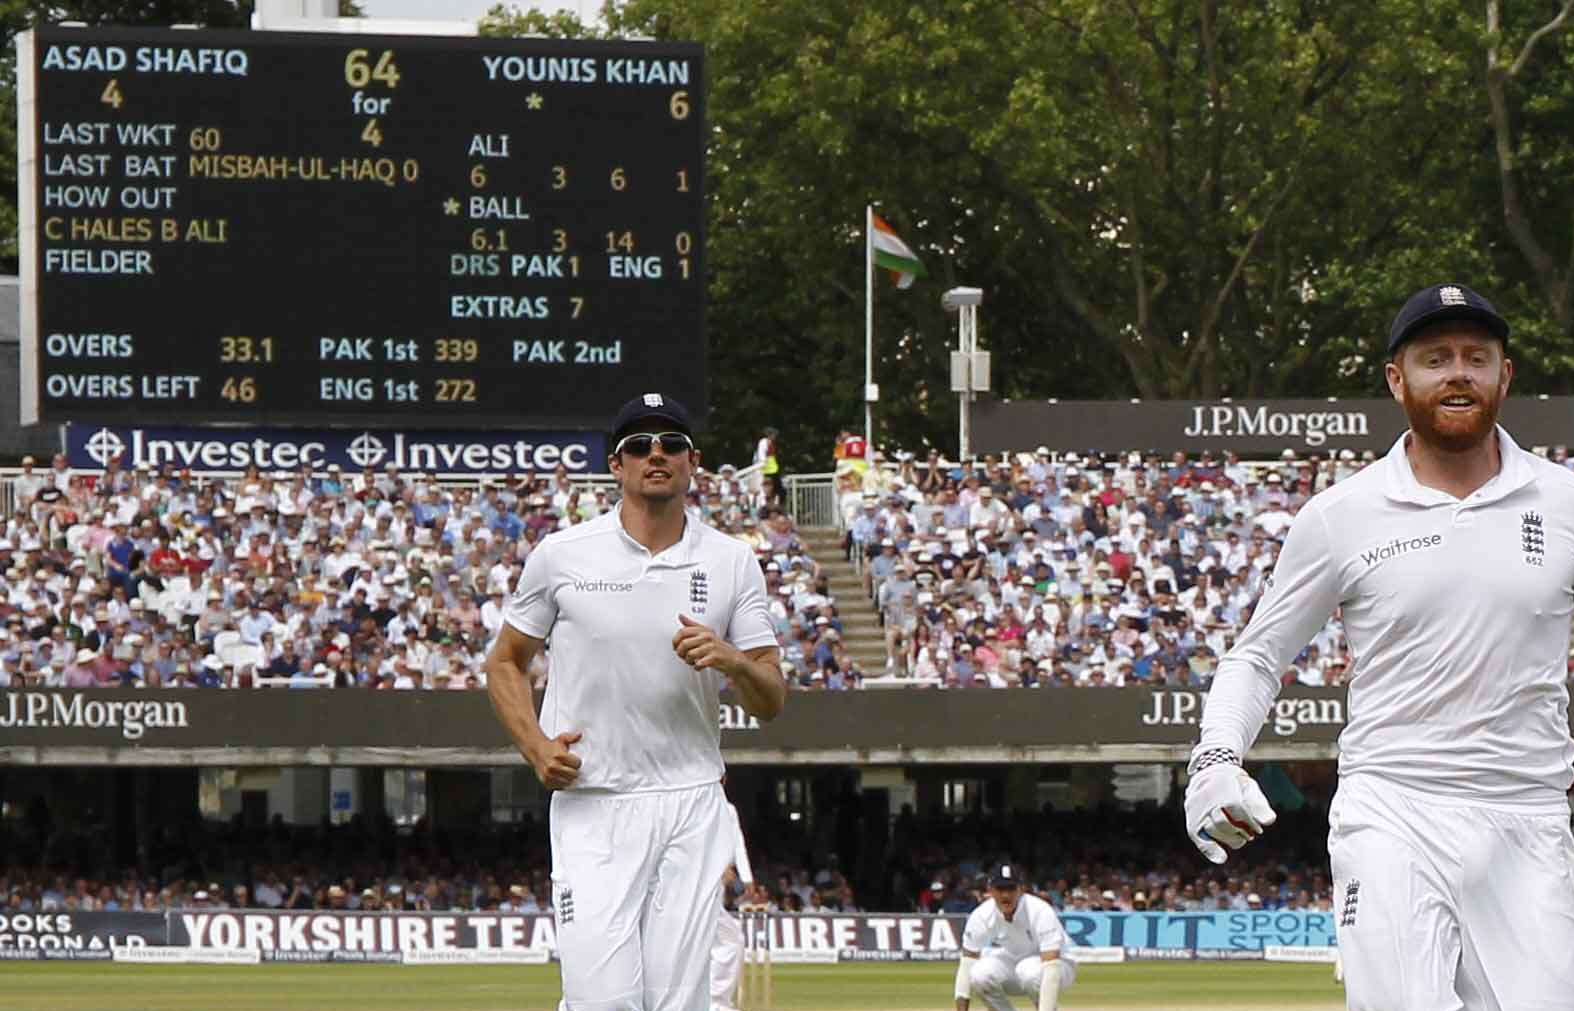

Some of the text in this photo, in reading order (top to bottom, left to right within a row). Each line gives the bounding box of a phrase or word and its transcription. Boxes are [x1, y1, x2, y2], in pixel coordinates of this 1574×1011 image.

[43, 46, 249, 75] ASAD SHAFIQ
[345, 49, 400, 88] 64
[483, 57, 689, 84] YOUNIS KHAN
[101, 79, 123, 109] 4
[353, 92, 390, 115] for
[670, 91, 689, 120] 6
[44, 123, 221, 151] LAST WKT 60
[361, 119, 383, 147] 4
[468, 135, 509, 158] ALI
[44, 155, 418, 186] LAST BAT MISBAH-UL-HAQ 0
[471, 165, 689, 193] 6 3 6 1
[46, 186, 176, 209] HOW OUT
[469, 197, 529, 220] BALL
[45, 218, 226, 243] C HALES B ALI
[472, 229, 691, 255] 6.1 3 14 0
[45, 250, 153, 275] FIELDER
[450, 254, 690, 280] DRS PAK 1 ENG 1
[451, 296, 584, 319] EXTRAS 7
[46, 334, 273, 363] OVERS 33.1
[320, 338, 478, 361] PAK 1st 339
[513, 341, 621, 364] PAK 2nd
[47, 375, 256, 402] OVERS LEFT 46
[320, 378, 477, 401] ENG 1st 272
[1184, 406, 1367, 446] J.P.Morgan
[132, 430, 325, 467] Investec
[395, 434, 588, 470] Investec
[1361, 534, 1442, 566] Waitrose
[573, 580, 633, 592] Waitrose
[0, 693, 188, 738] J.P.Morgan
[1143, 691, 1345, 735] J.P.gan
[183, 913, 557, 951] YORKSHIRE TEA
[867, 918, 960, 951] TEA
[1229, 914, 1334, 933] SPOR
